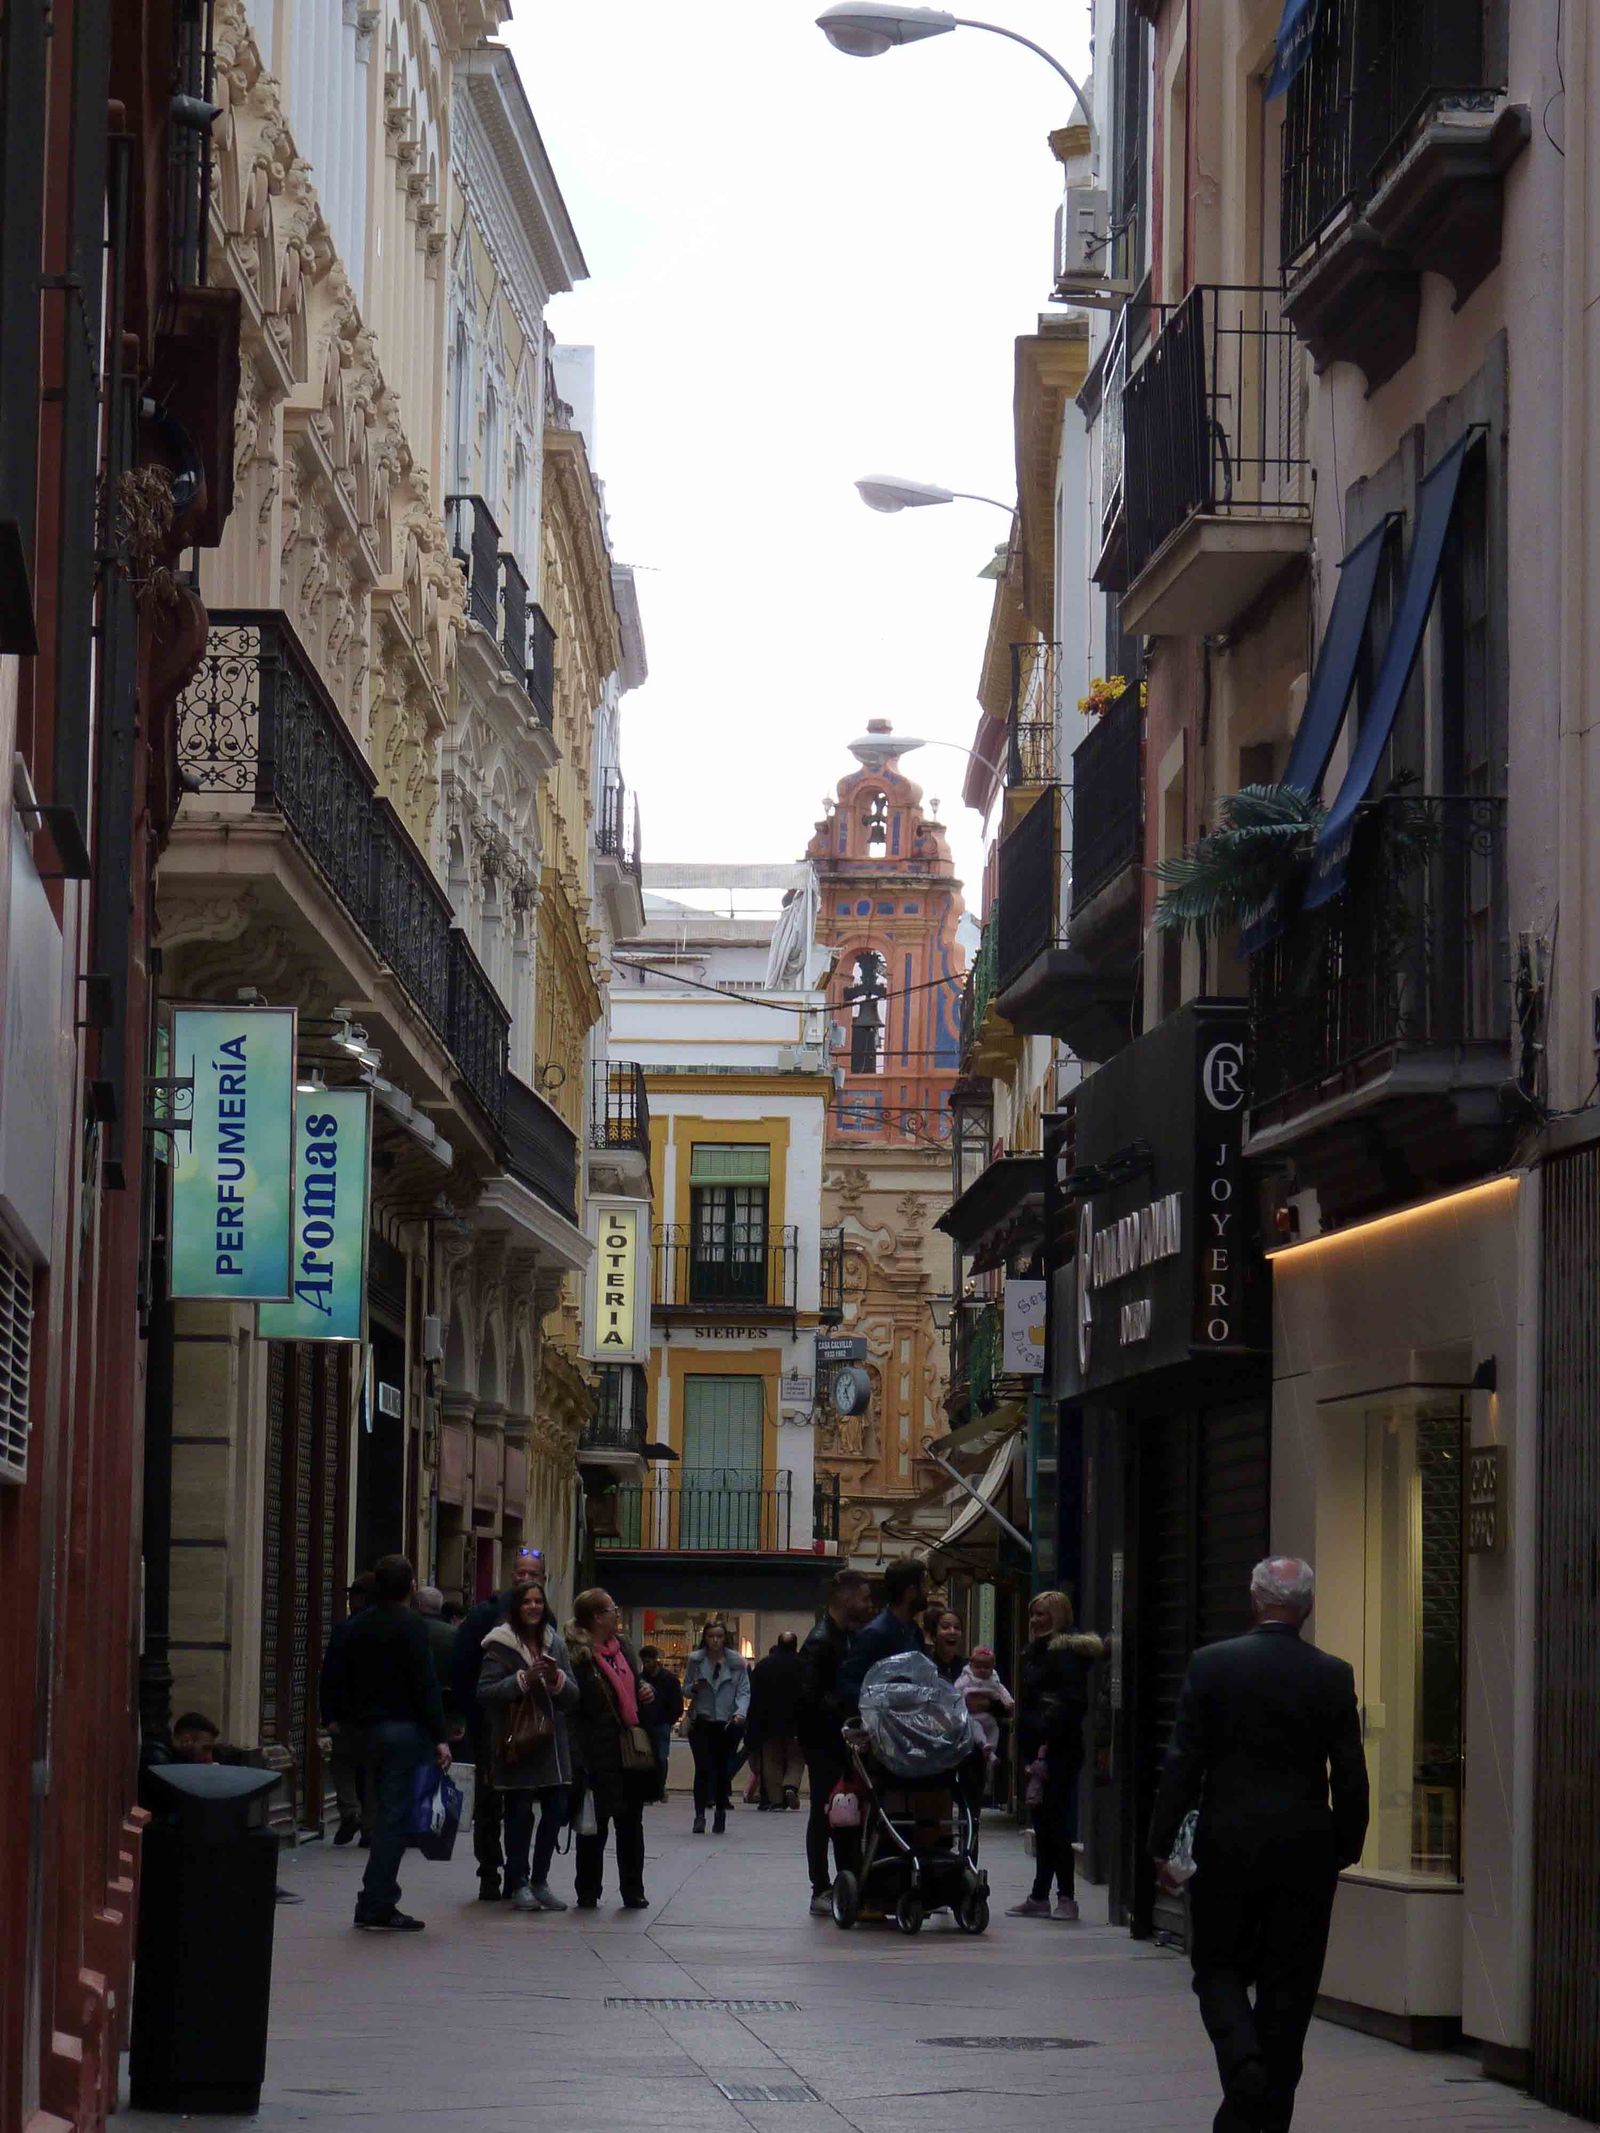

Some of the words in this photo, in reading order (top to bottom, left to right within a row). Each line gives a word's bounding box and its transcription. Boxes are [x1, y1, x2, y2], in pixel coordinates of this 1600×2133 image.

[212, 1034, 247, 1275] PERFUMERÍA
[295, 1113, 338, 1317] Aromas
[1207, 1143, 1232, 1341] JOYERO
[602, 1215, 628, 1345] LOTERIA
[695, 1327, 768, 1339] SIERPES
